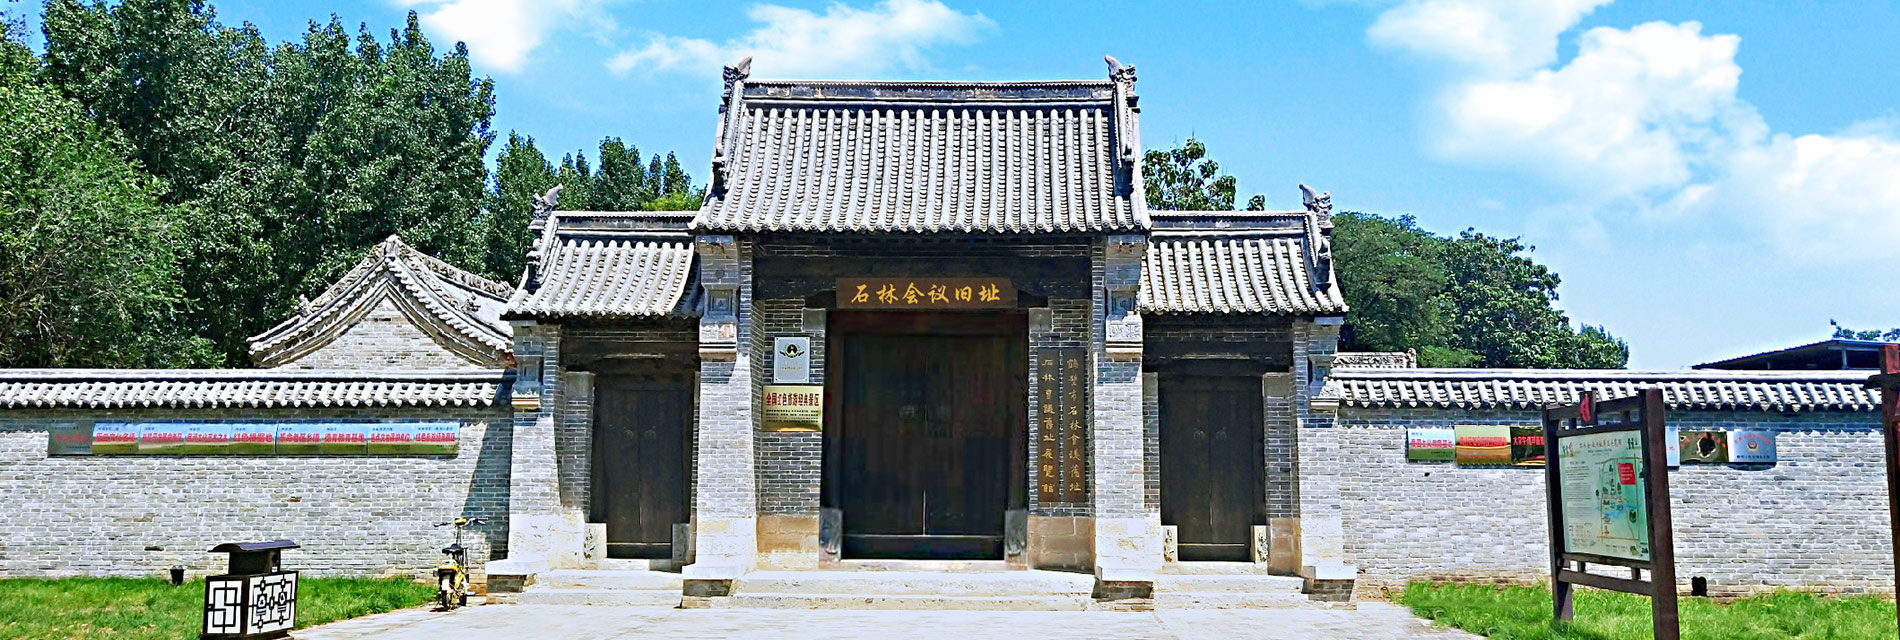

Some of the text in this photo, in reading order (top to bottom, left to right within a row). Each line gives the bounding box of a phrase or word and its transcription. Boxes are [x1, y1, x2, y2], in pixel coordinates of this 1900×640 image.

[851, 282, 1001, 304] 石林会议旧址
[766, 393, 820, 406] 全国红色旅游经典景区
[233, 432, 273, 443] 红色根据地
[370, 433, 411, 442] 重点文物保护单位
[1411, 438, 1453, 448] 爱国主义教育基地
